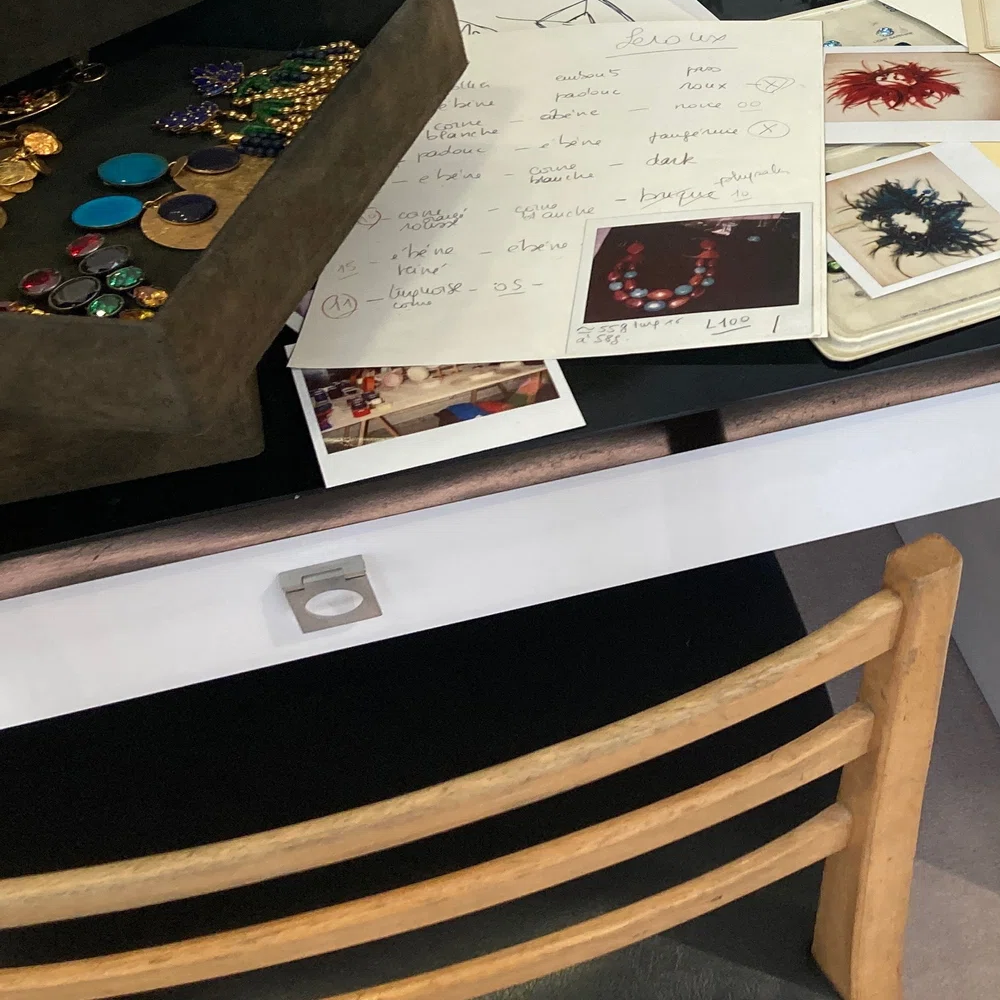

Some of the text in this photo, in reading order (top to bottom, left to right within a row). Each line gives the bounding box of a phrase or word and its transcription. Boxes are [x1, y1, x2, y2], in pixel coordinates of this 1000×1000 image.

[426, 127, 500, 141] blanche
[417, 145, 489, 164] padouc
[645, 152, 700, 167] dark
